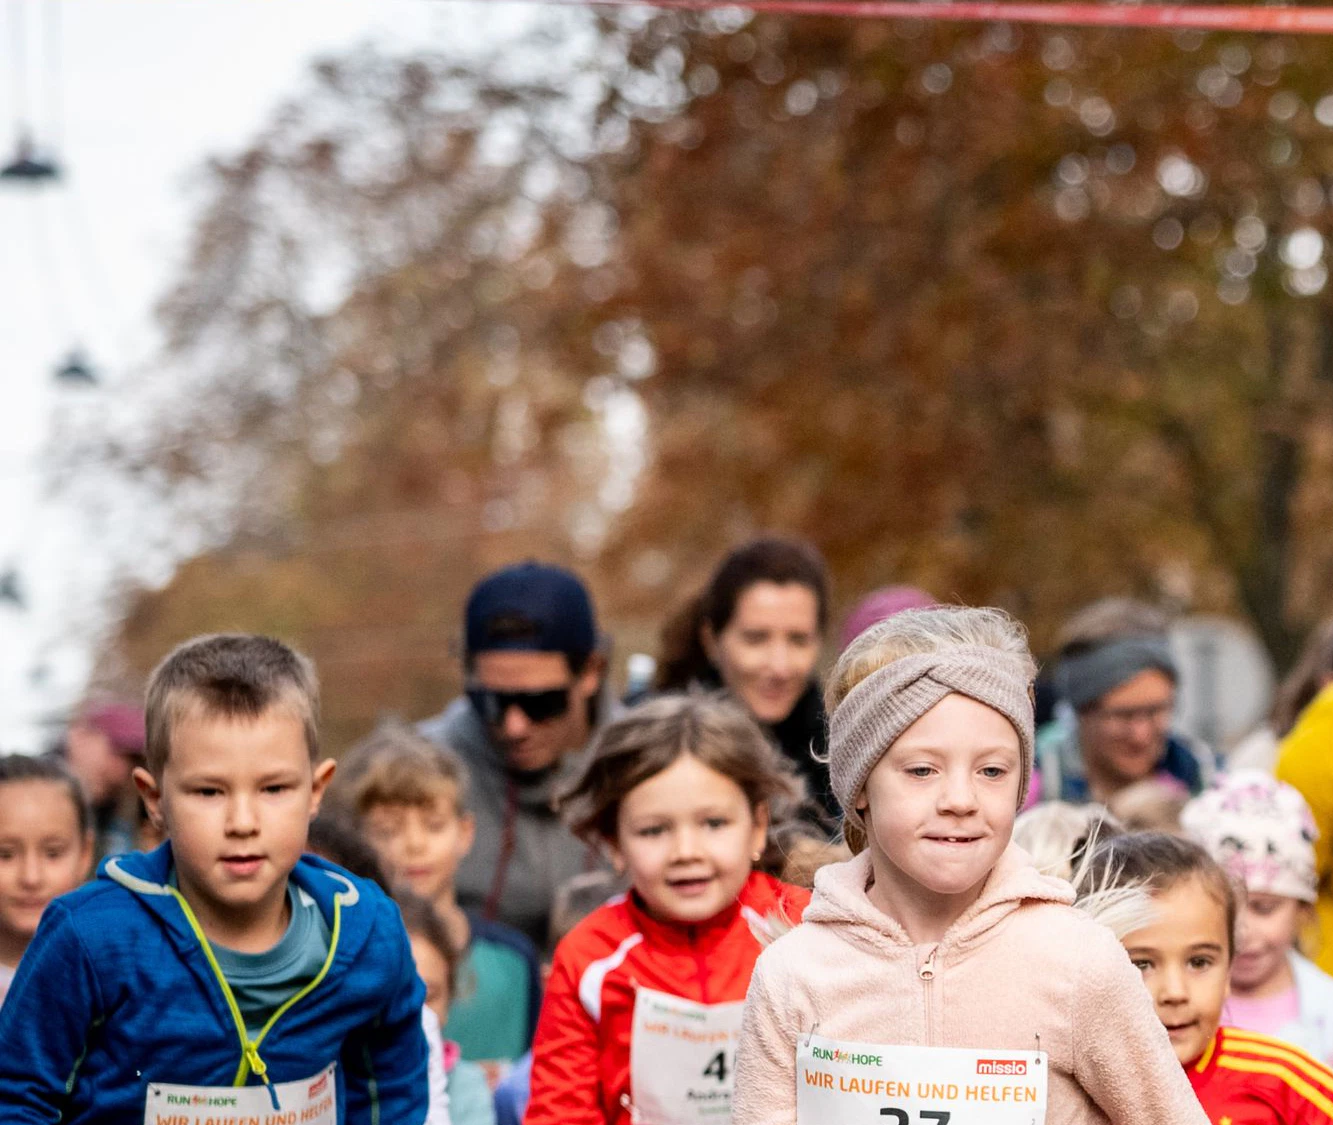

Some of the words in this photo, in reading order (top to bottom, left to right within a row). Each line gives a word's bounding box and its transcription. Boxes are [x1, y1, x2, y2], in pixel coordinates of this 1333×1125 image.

[703, 1051, 737, 1082] 4
[812, 1047, 833, 1060] RUN
[851, 1054, 883, 1067] HOPE
[978, 1061, 1026, 1075] missio
[805, 1069, 834, 1089] WIR
[839, 1076, 911, 1098] LAUFEN
[918, 1084, 959, 1100] UND
[966, 1086, 1037, 1102] HELFEN
[167, 1093, 191, 1105] RUN
[208, 1096, 237, 1107] HOPE
